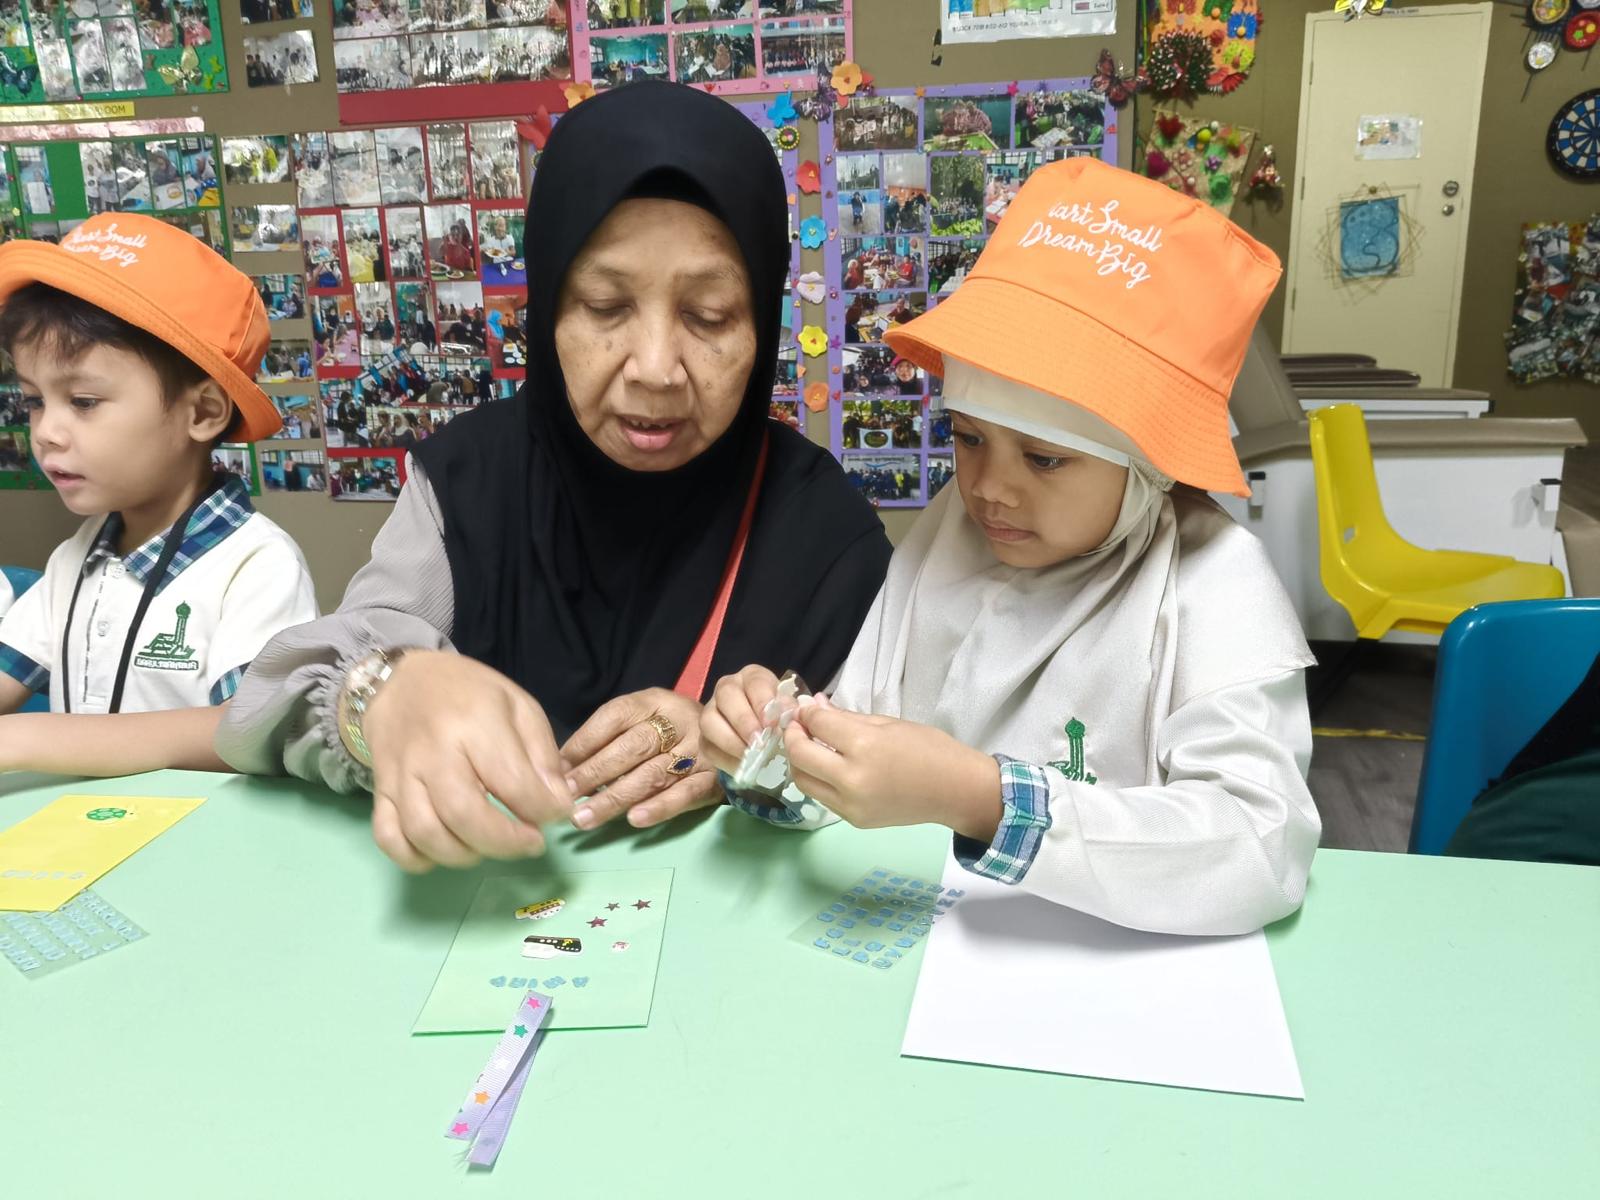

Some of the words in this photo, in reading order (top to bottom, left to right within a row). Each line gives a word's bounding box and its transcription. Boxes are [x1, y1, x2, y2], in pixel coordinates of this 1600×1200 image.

[97, 223, 147, 248] Small
[1088, 199, 1162, 252] Small
[99, 244, 139, 267] Big
[1017, 221, 1098, 257] Dream
[1095, 239, 1151, 289] Big
